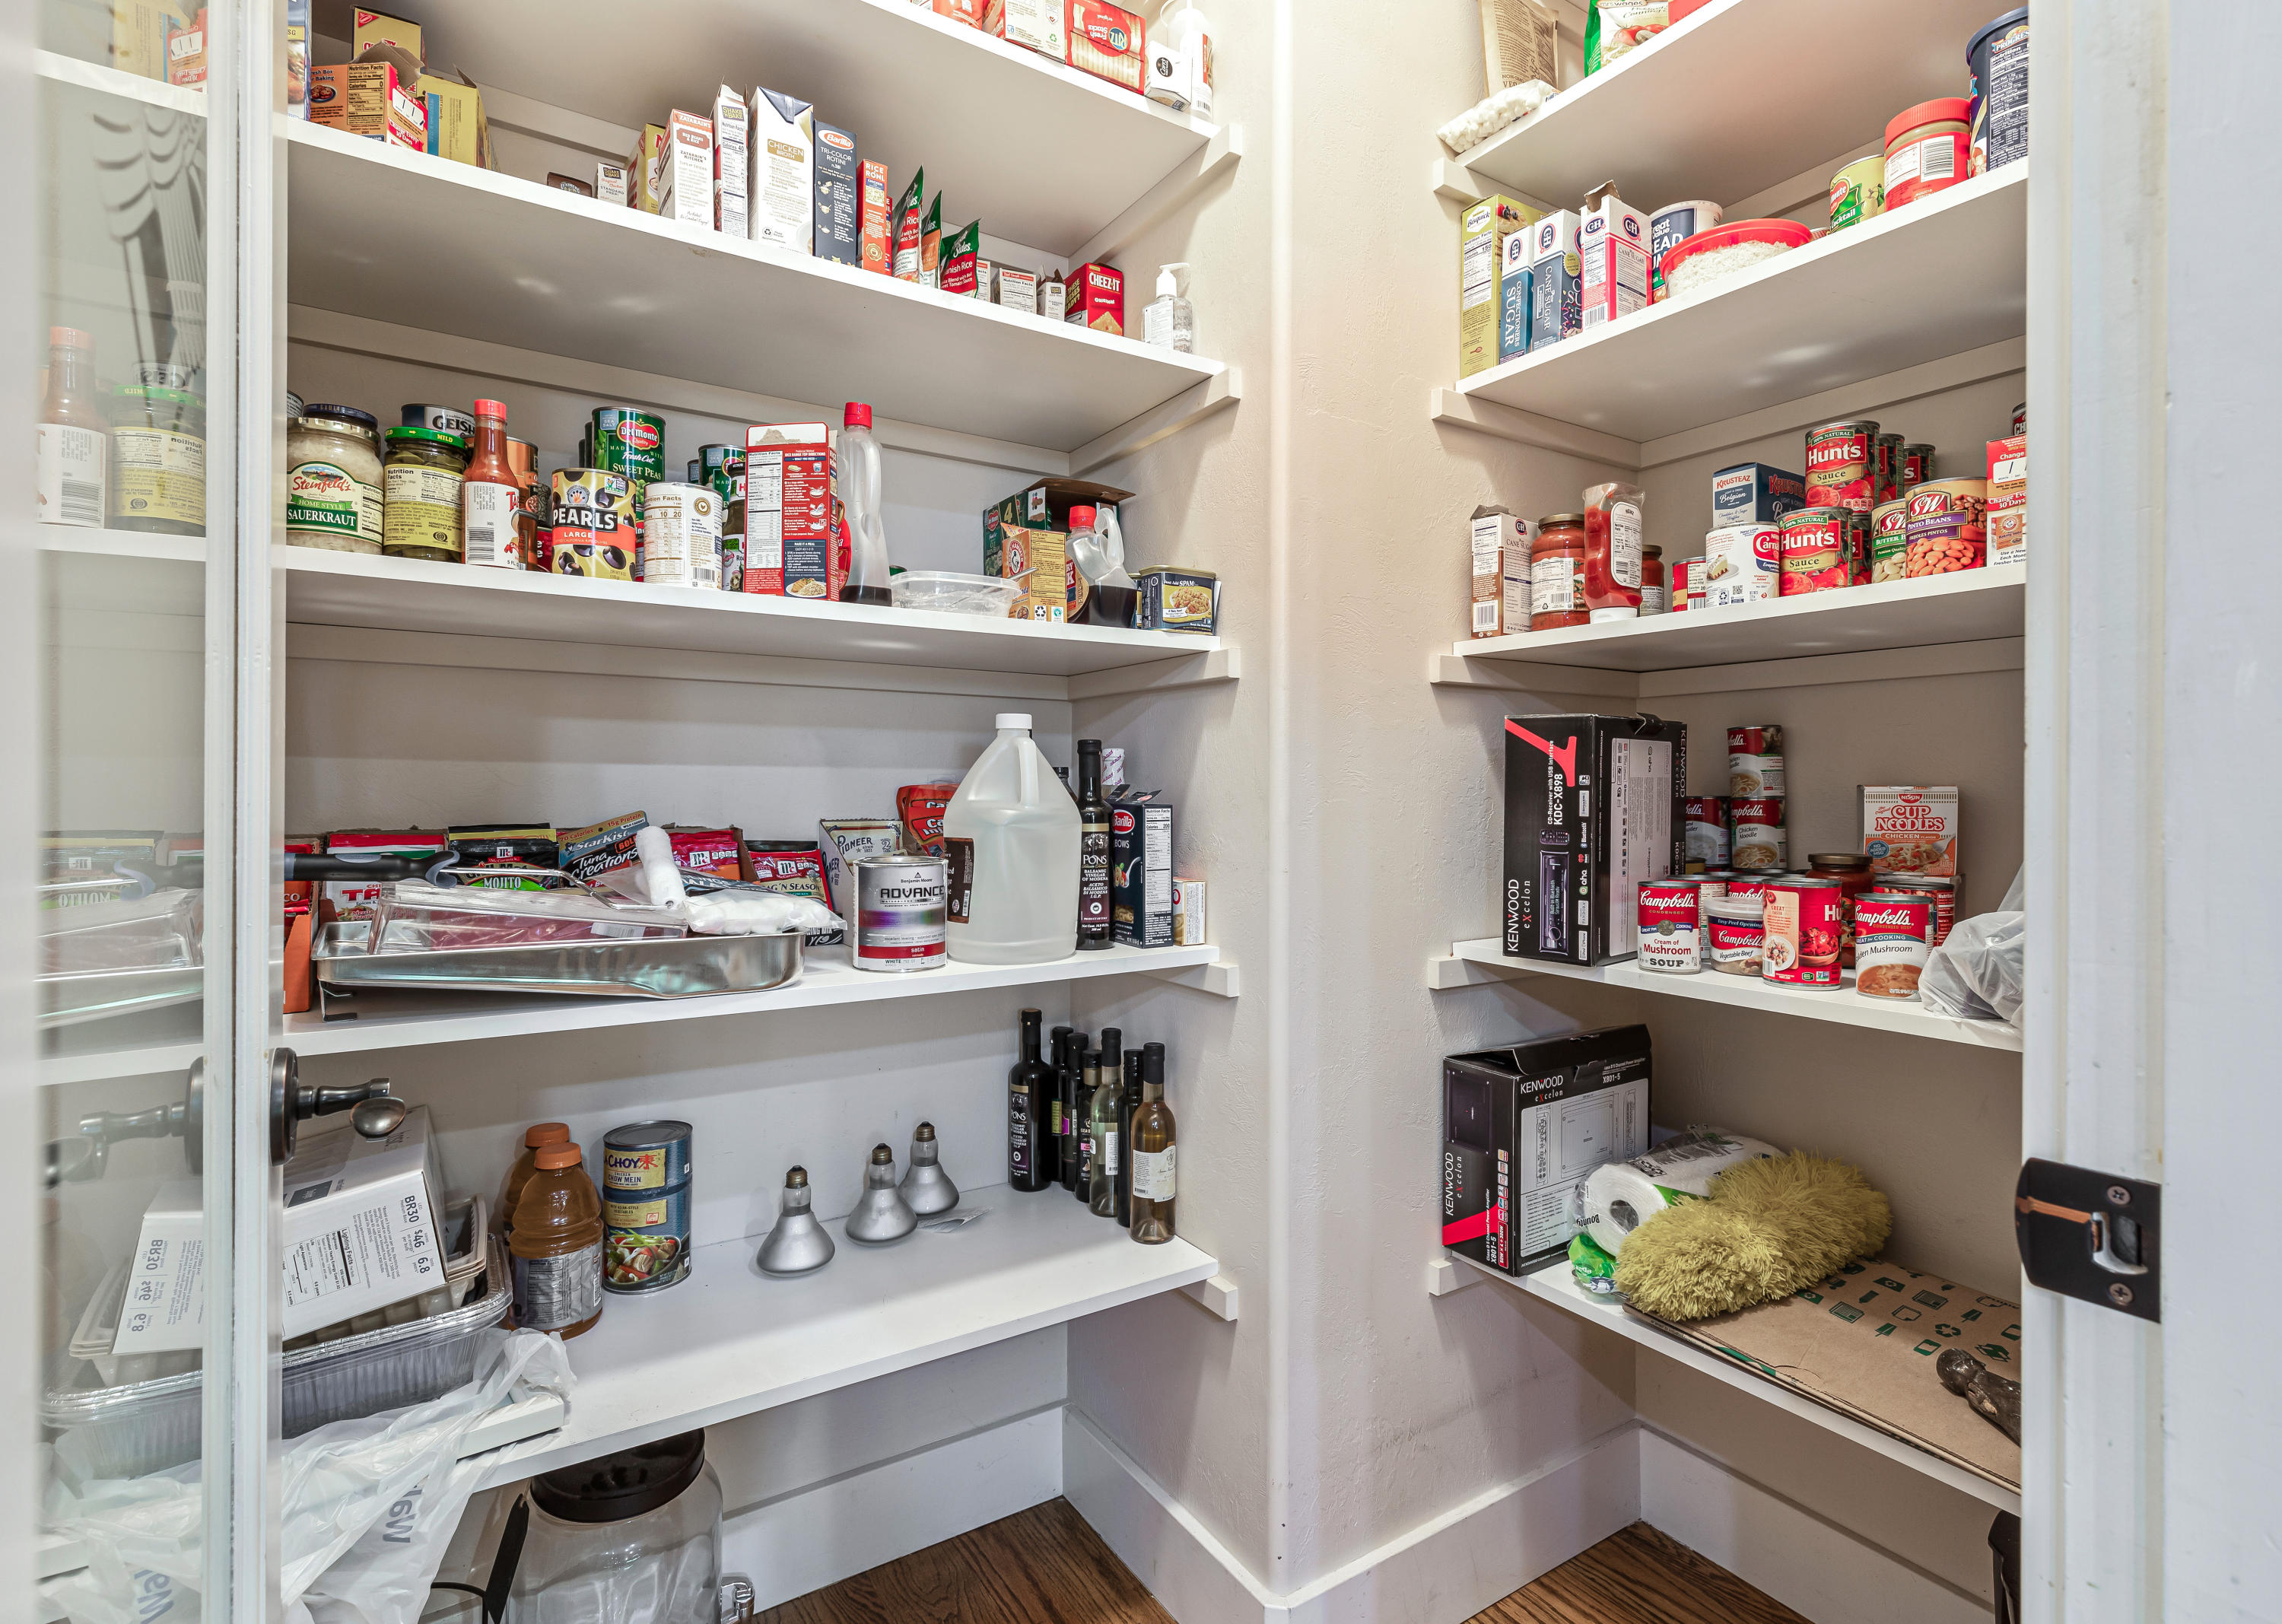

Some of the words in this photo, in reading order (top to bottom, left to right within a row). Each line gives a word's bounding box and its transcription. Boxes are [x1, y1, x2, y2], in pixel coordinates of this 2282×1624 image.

[1089, 31, 1108, 40] Fresh
[1110, 27, 1128, 50] RITZ
[723, 106, 743, 115] SHAKE
[679, 114, 712, 129] ZATARAIN'S
[826, 133, 851, 147] Barilla
[768, 139, 804, 157] CHICKEN
[776, 149, 796, 160] BROTH
[820, 146, 853, 162] TRI-COLOR
[826, 154, 846, 166] ROTINI
[865, 162, 884, 174] RICE
[600, 186, 625, 195] STANDARD
[1467, 211, 1490, 227] Bisquick
[1832, 208, 1856, 229] Cocktail
[1481, 243, 1492, 253] 150
[1618, 246, 1632, 256] CANE
[961, 260, 973, 270] Rice
[1544, 265, 1553, 294] CANE
[1505, 287, 1516, 348] SUGAR
[1544, 295, 1553, 331] SUGAR
[437, 434, 453, 443] MILD
[1813, 436, 1824, 444] 100%
[622, 451, 641, 462] Fresh
[2000, 451, 2025, 460] Change
[612, 462, 644, 476] SWEET
[644, 466, 662, 481] PEAS
[1817, 469, 1846, 482] Sauce
[292, 475, 351, 493] Steinfeld's
[1717, 474, 1751, 489] KRUSTEAZ
[1719, 491, 1747, 504] Belgian
[1988, 494, 2013, 504] Change
[1998, 501, 2008, 510] 30
[2008, 498, 2026, 507] Days
[298, 499, 319, 507] HOME
[320, 502, 345, 510] STYLE
[288, 508, 356, 527] SAUERKRAUT
[553, 508, 614, 529] PEARLS
[1003, 502, 1013, 523] 4
[1797, 516, 1825, 525] NATURAL
[1908, 520, 1925, 531] PINTO
[1925, 516, 1952, 526] BEANS
[1927, 528, 1948, 537] PINTOS
[1506, 539, 1521, 548] CANE
[1876, 536, 1900, 545] BUTTER
[1789, 558, 1820, 568] Sauce
[1553, 774, 1563, 825] KDC-X898
[620, 813, 641, 822] Protein
[1891, 805, 1931, 818] CUP
[1738, 826, 1759, 834] Chicken
[1874, 817, 1945, 831] NOODLES
[570, 828, 594, 839] Calories
[576, 830, 629, 850] StarKist
[1739, 831, 1758, 840] Noodle
[836, 834, 873, 855] PIONEER
[570, 847, 637, 881] Creations
[573, 852, 606, 869] Tuna
[1082, 854, 1108, 865] PONS
[483, 876, 521, 889] MOJITO
[790, 882, 820, 891] SEASON
[880, 885, 944, 898] ADVANCE
[1640, 890, 1696, 907] Campbell's
[1507, 879, 1520, 952] KENWOOD
[1643, 943, 1692, 955] Mushroom
[1719, 951, 1740, 959] Vegetable
[1741, 950, 1754, 958] Beef
[1869, 945, 1912, 955] Mushroom
[1649, 958, 1686, 968] SOUP
[1603, 1073, 1621, 1083] X801-5
[1521, 1075, 1563, 1095] KENWOOD
[608, 1154, 640, 1169] CHOY
[608, 1174, 624, 1184] CHOW
[1445, 1152, 1454, 1216] KENWOOD
[405, 1195, 419, 1222] BR30
[1577, 1213, 1600, 1227] Bounty
[342, 1228, 350, 1251] Lighting
[414, 1229, 425, 1248] $46
[418, 1257, 431, 1274] 6.8
